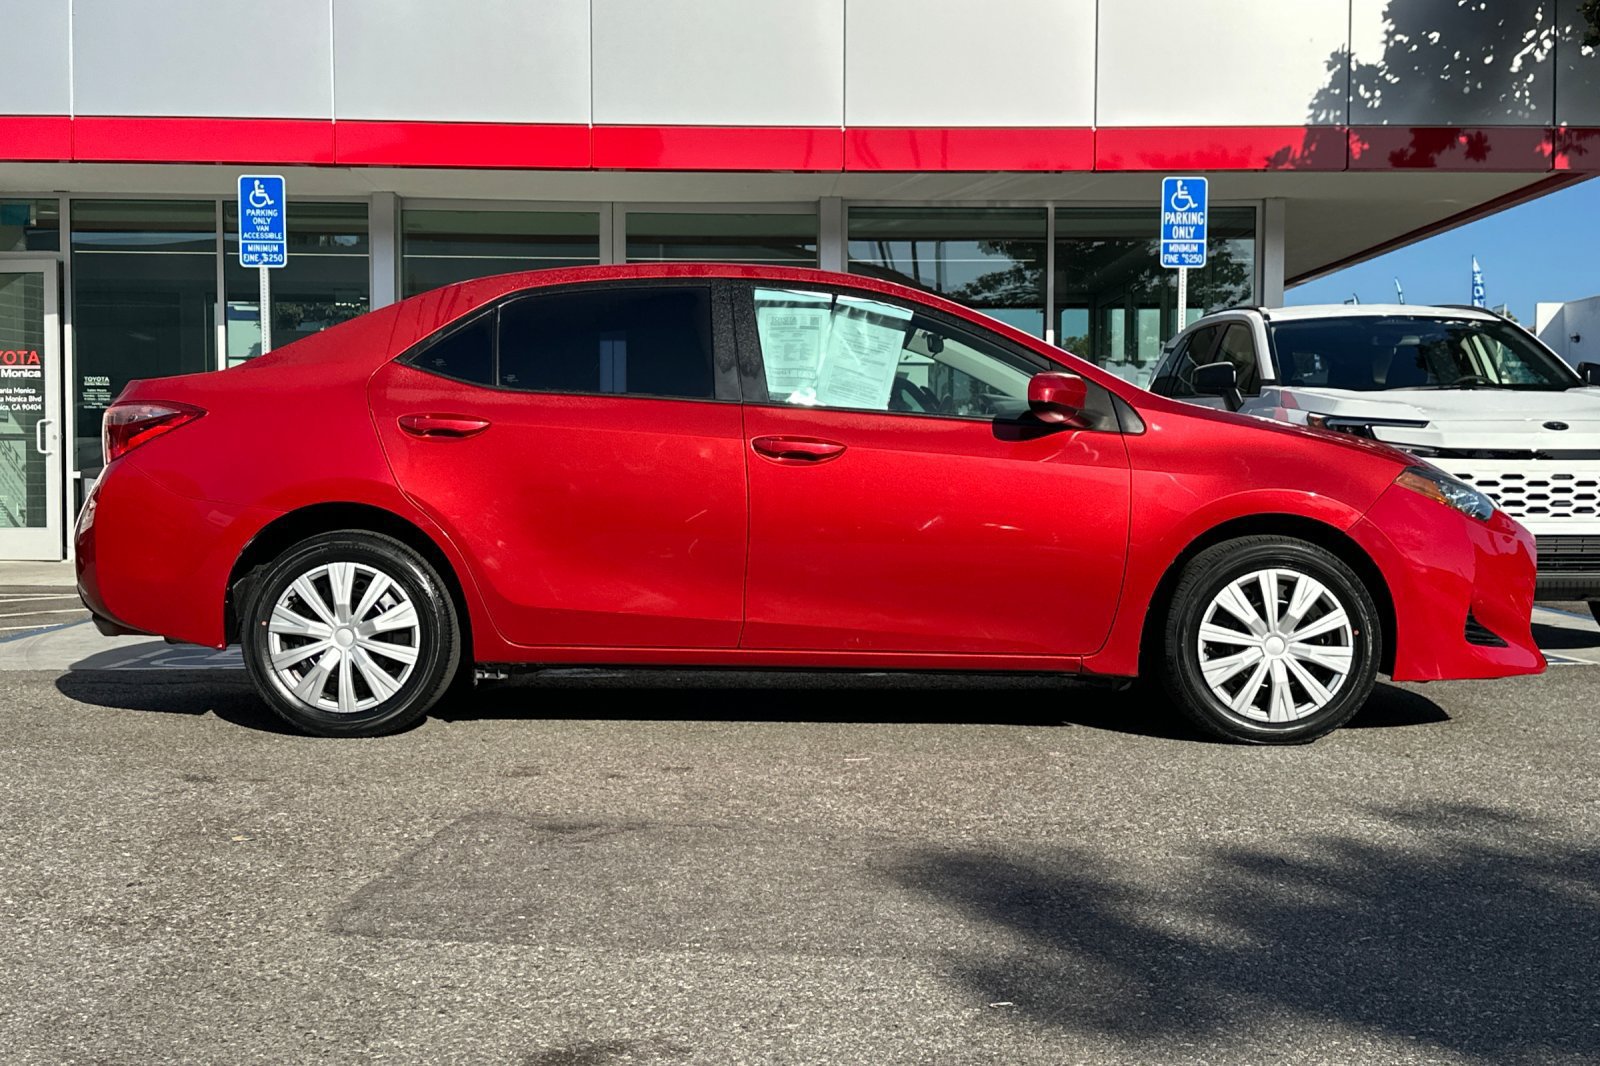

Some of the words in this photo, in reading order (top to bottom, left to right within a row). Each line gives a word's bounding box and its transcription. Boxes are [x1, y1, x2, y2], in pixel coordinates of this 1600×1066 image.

[1165, 211, 1204, 225] PARKING
[1172, 226, 1195, 239] ONLY
[247, 244, 279, 252] MINIMUM
[1169, 244, 1199, 252] MINIMUM
[1164, 254, 1180, 263] FINE
[1, 369, 41, 378] Monica
